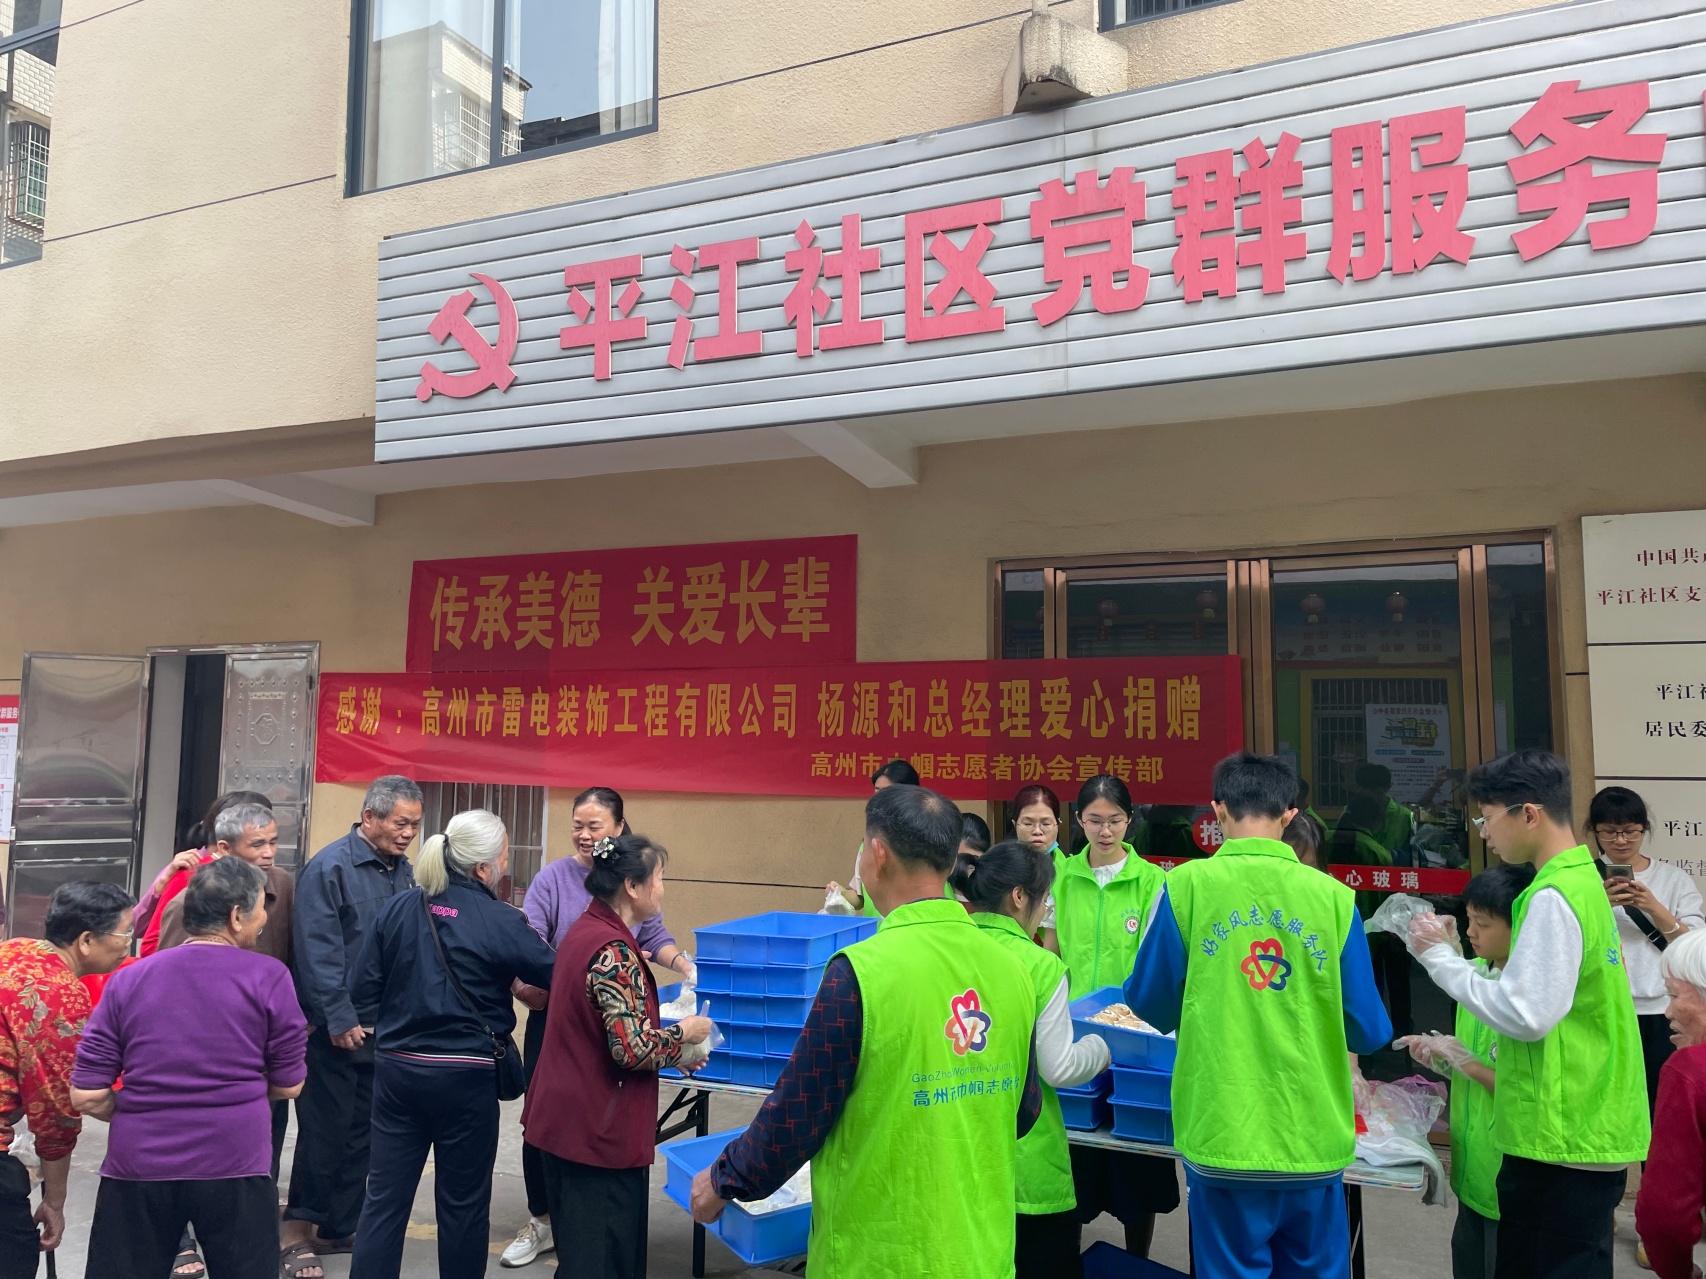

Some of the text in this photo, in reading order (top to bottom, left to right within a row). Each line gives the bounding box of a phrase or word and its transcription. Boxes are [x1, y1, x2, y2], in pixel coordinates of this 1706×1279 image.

[559, 80, 1706, 380] 平江社区党群服务
[1637, 547, 1706, 567] 中国共
[429, 557, 830, 652] 传承美德 关爱长辈
[1595, 586, 1702, 605] 平江社区支
[817, 674, 1202, 741] 杨源和总经理爱心捐赠
[1646, 720, 1706, 738] 居民委
[810, 751, 1164, 784] 高州市帼志愿者协会宣传部
[1200, 820, 1224, 846] 推
[1662, 820, 1703, 836] 平江
[1329, 869, 1419, 889] 心玻璃
